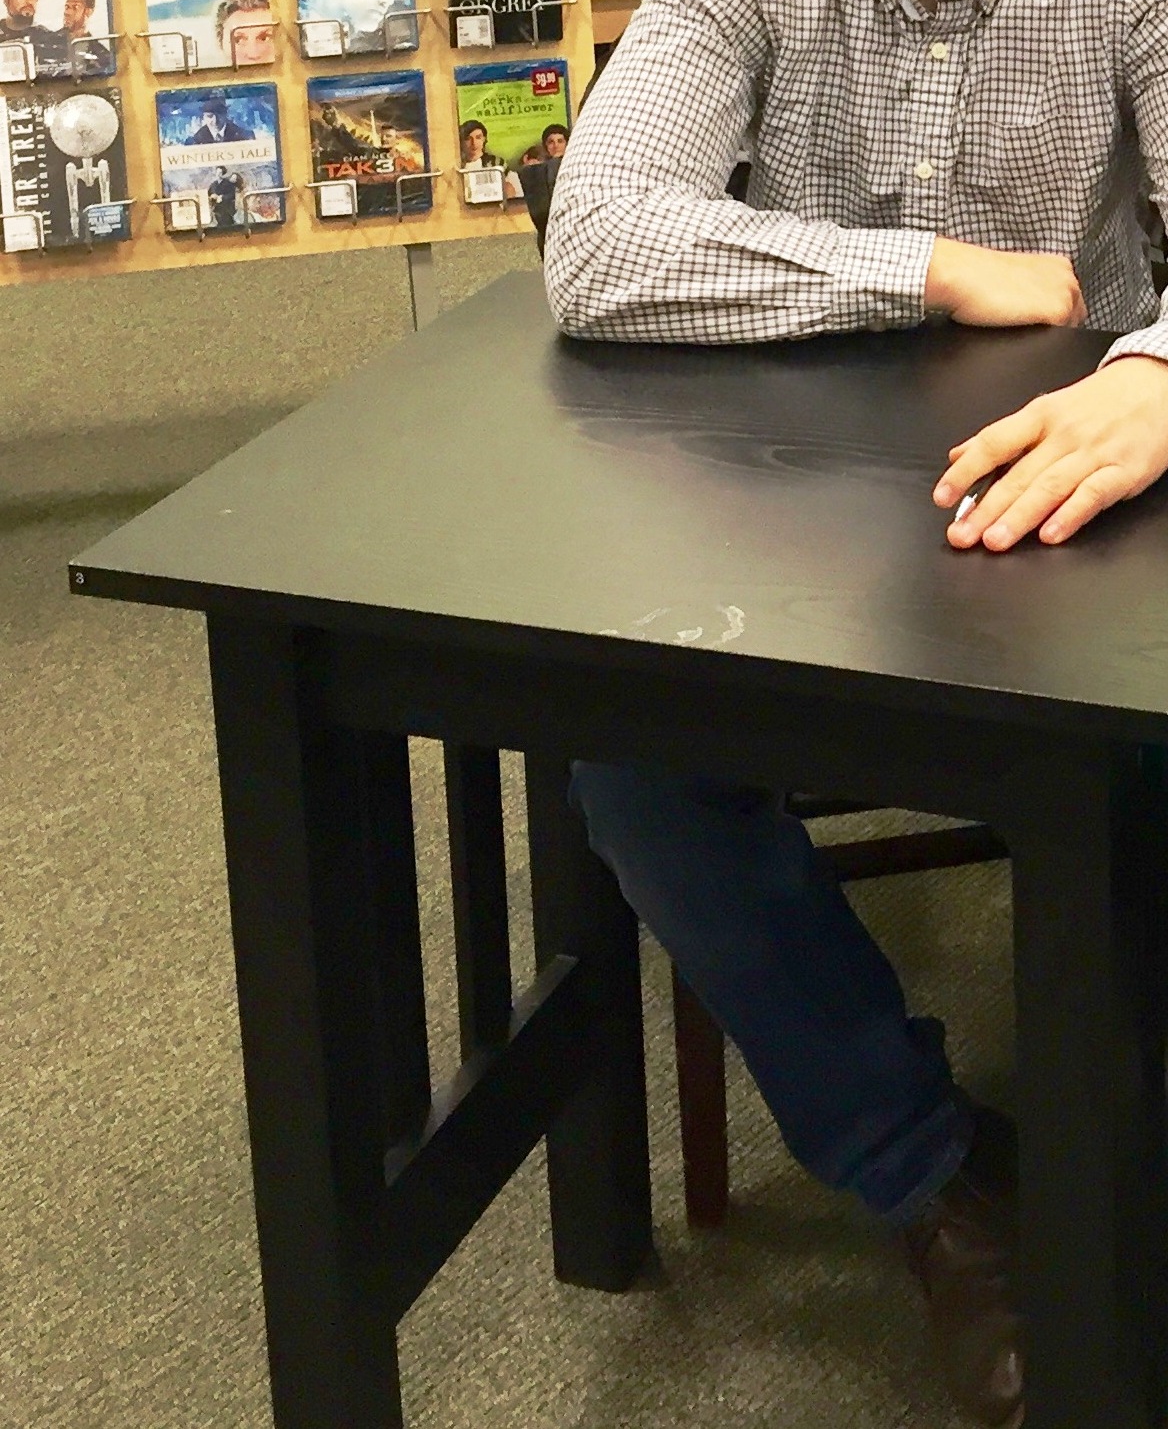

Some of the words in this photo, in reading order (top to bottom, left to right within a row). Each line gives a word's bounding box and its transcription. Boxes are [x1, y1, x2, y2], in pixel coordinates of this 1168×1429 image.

[475, 103, 554, 117] wallflower
[10, 106, 36, 164] TREK
[168, 149, 237, 165] WINTER'S
[240, 147, 271, 159] TALE
[325, 158, 418, 179] TAK3N
